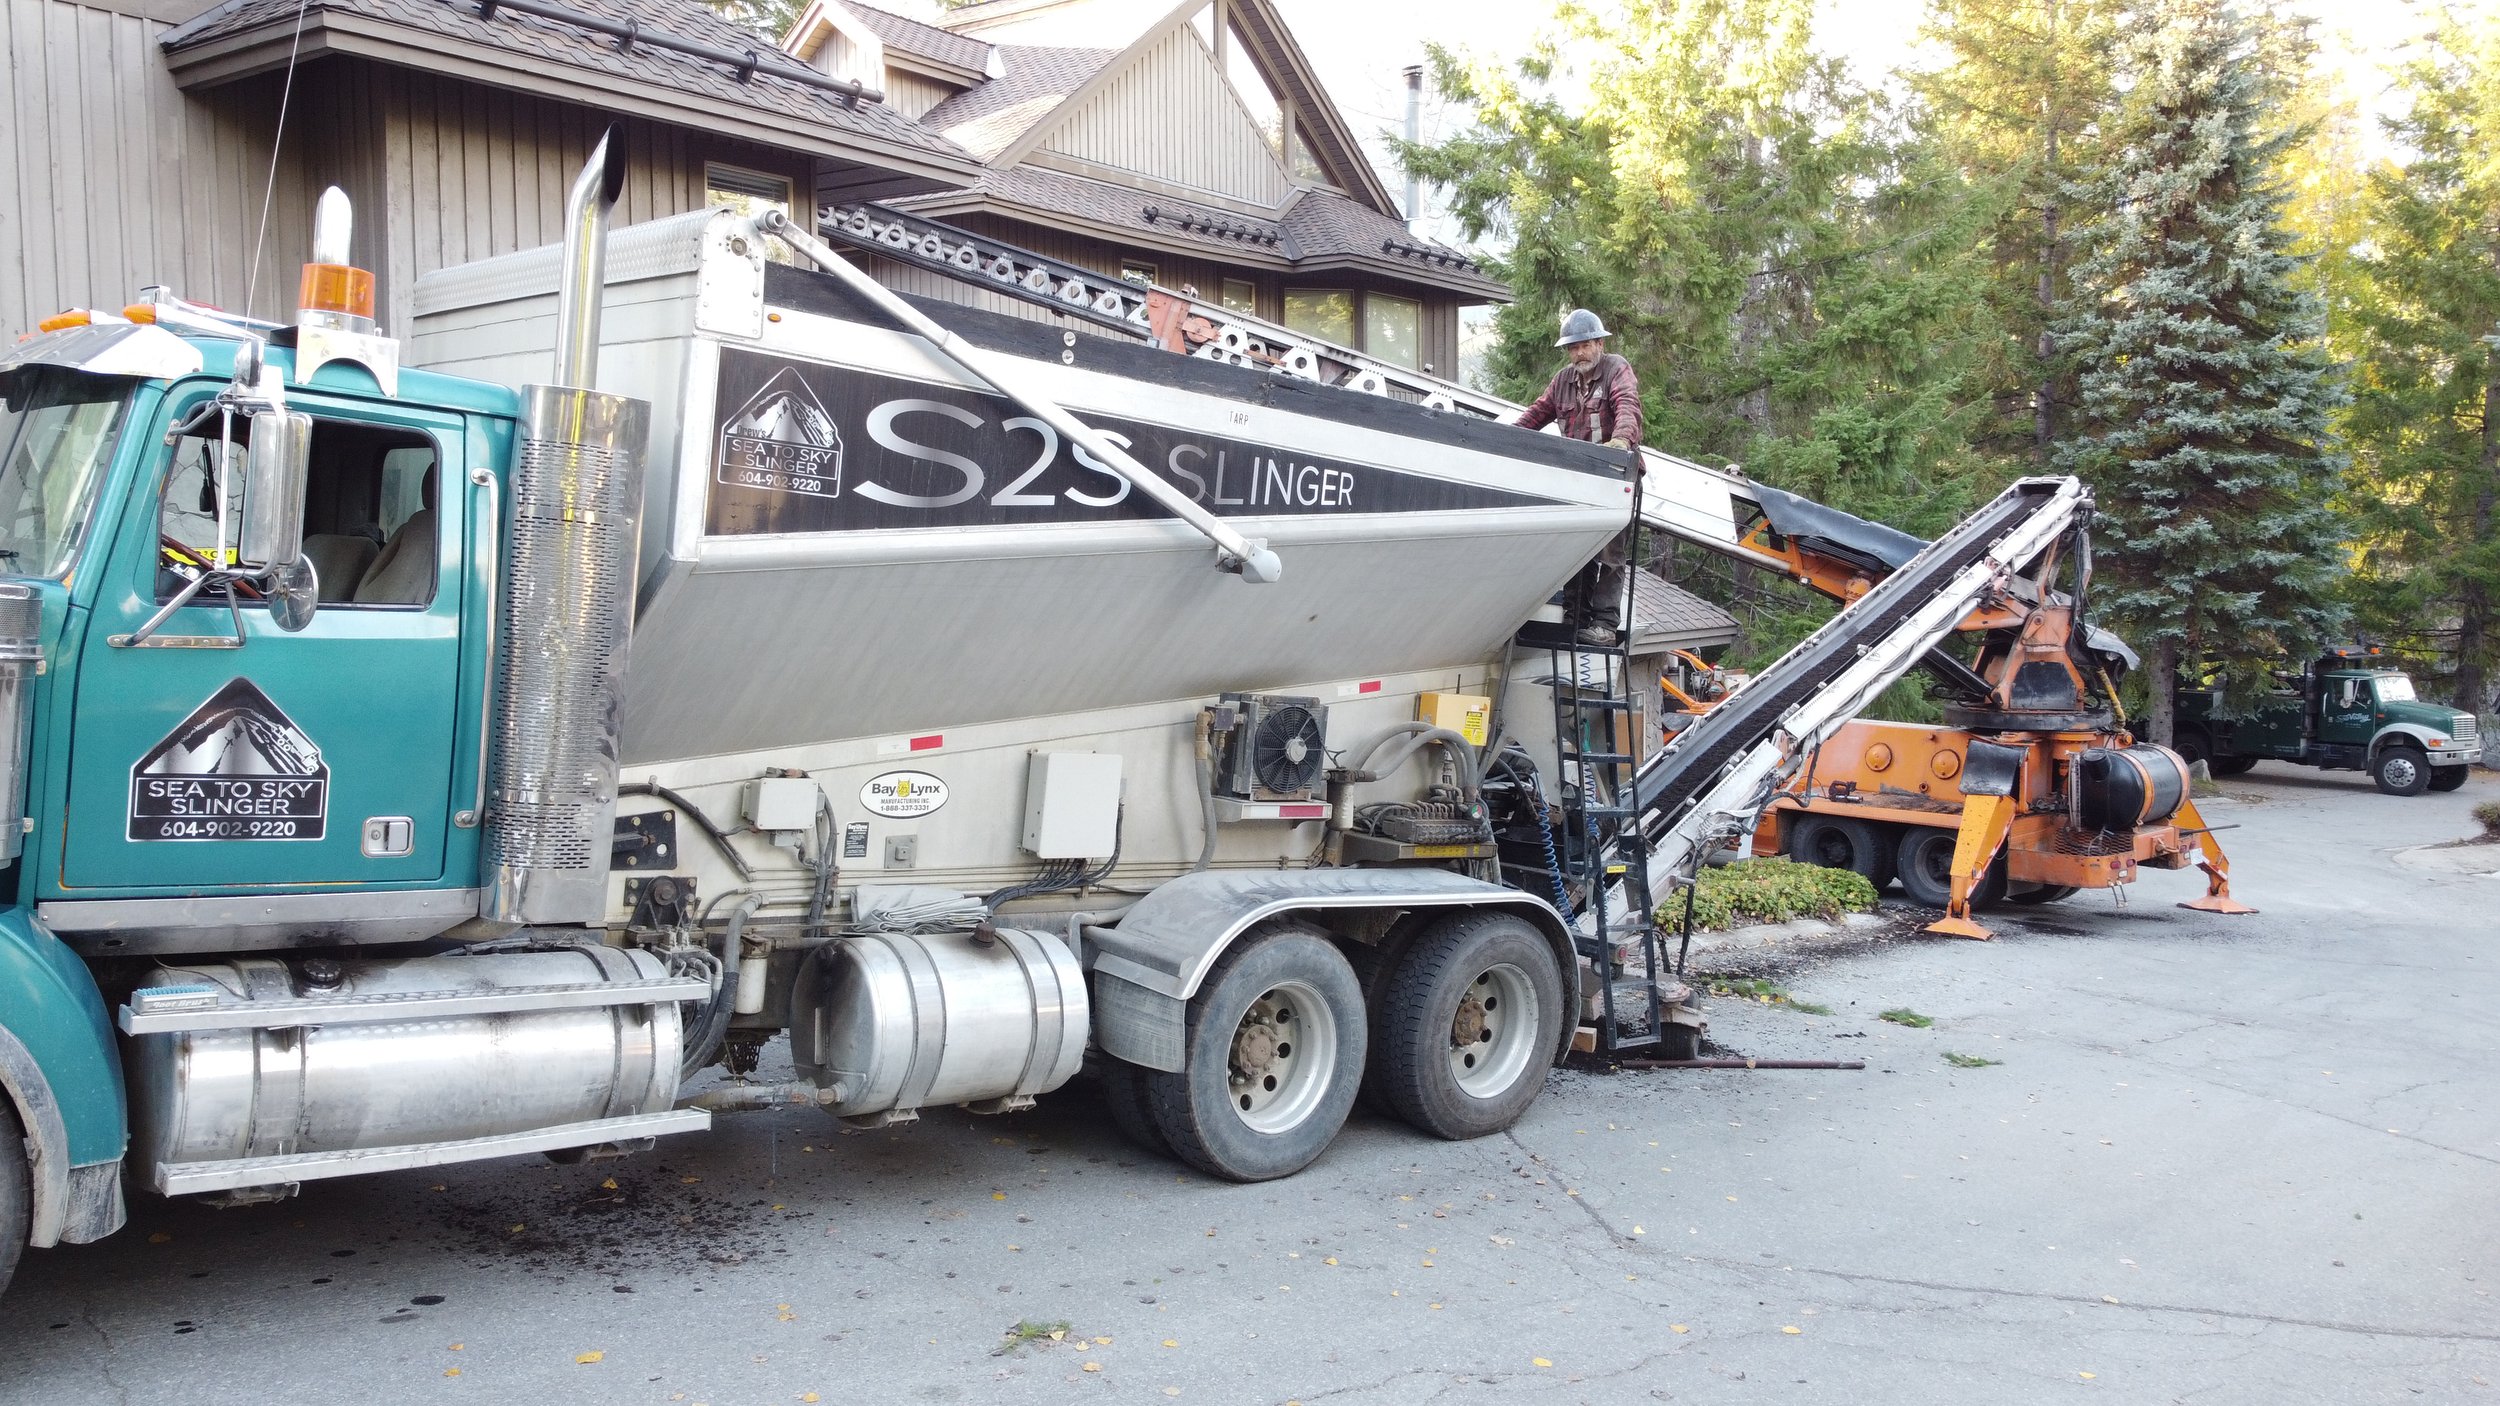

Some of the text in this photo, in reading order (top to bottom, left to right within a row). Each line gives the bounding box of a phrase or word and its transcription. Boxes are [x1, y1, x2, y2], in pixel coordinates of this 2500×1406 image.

[1229, 410, 1249, 426] TARP
[732, 439, 832, 464] SEA TO SKY
[852, 399, 1354, 508] S2S SLINGER
[745, 454, 818, 475] SLINGER
[738, 470, 821, 492] 604-902-9220
[148, 781, 313, 798] SEA TO SKY
[872, 783, 941, 796] Bay Lynx
[170, 798, 290, 815] SLINGER
[160, 821, 296, 837] 604-902-9220
